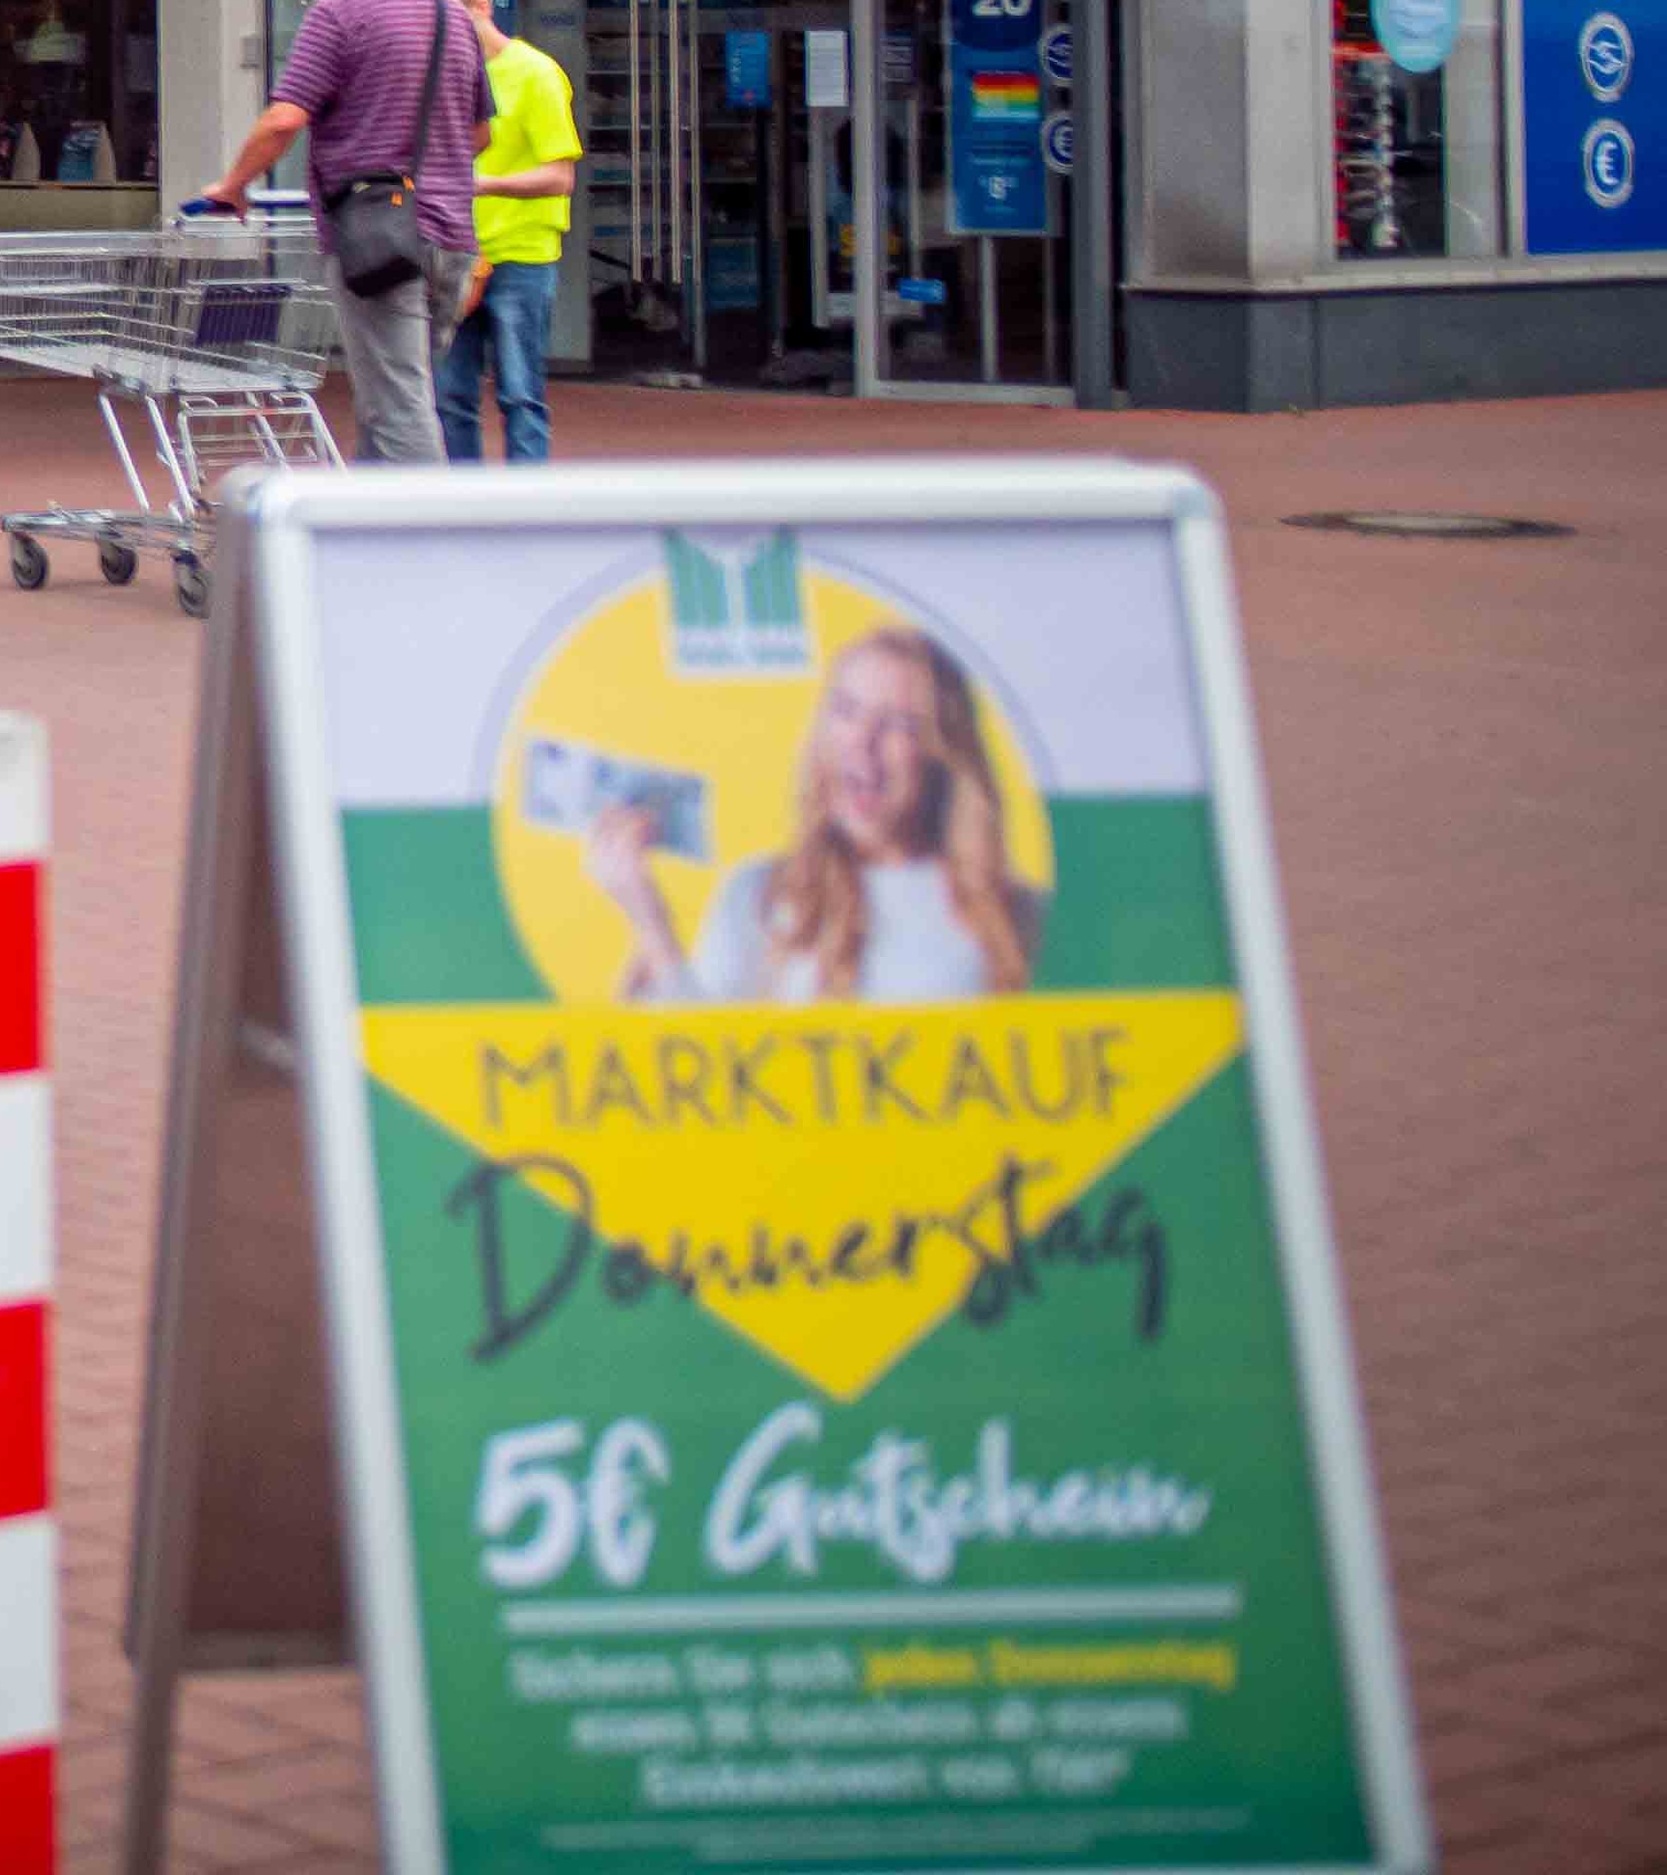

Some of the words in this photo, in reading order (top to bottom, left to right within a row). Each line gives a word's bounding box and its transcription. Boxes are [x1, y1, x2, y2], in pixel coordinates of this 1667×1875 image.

[478, 1025, 1134, 1130] MARKTKAUF
[446, 1151, 1170, 1364] Donnerstag
[702, 1400, 1210, 1585] Gutschein
